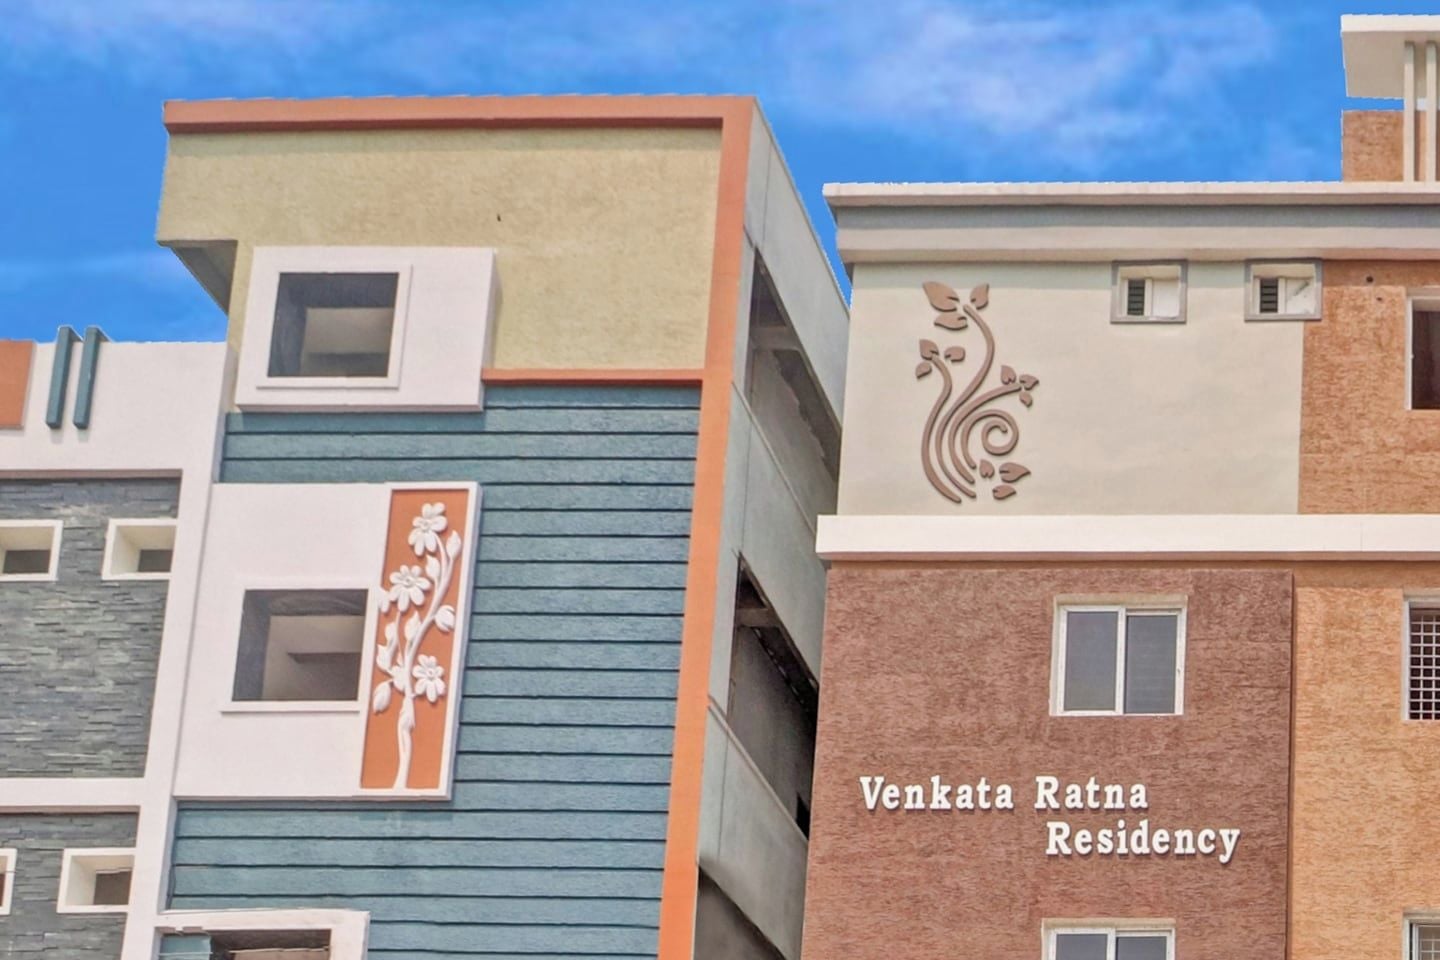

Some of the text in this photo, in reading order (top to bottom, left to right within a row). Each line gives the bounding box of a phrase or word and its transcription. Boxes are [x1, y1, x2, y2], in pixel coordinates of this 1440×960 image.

[859, 775, 1149, 810] Venkata Ratna
[1045, 820, 1241, 863] Residency
